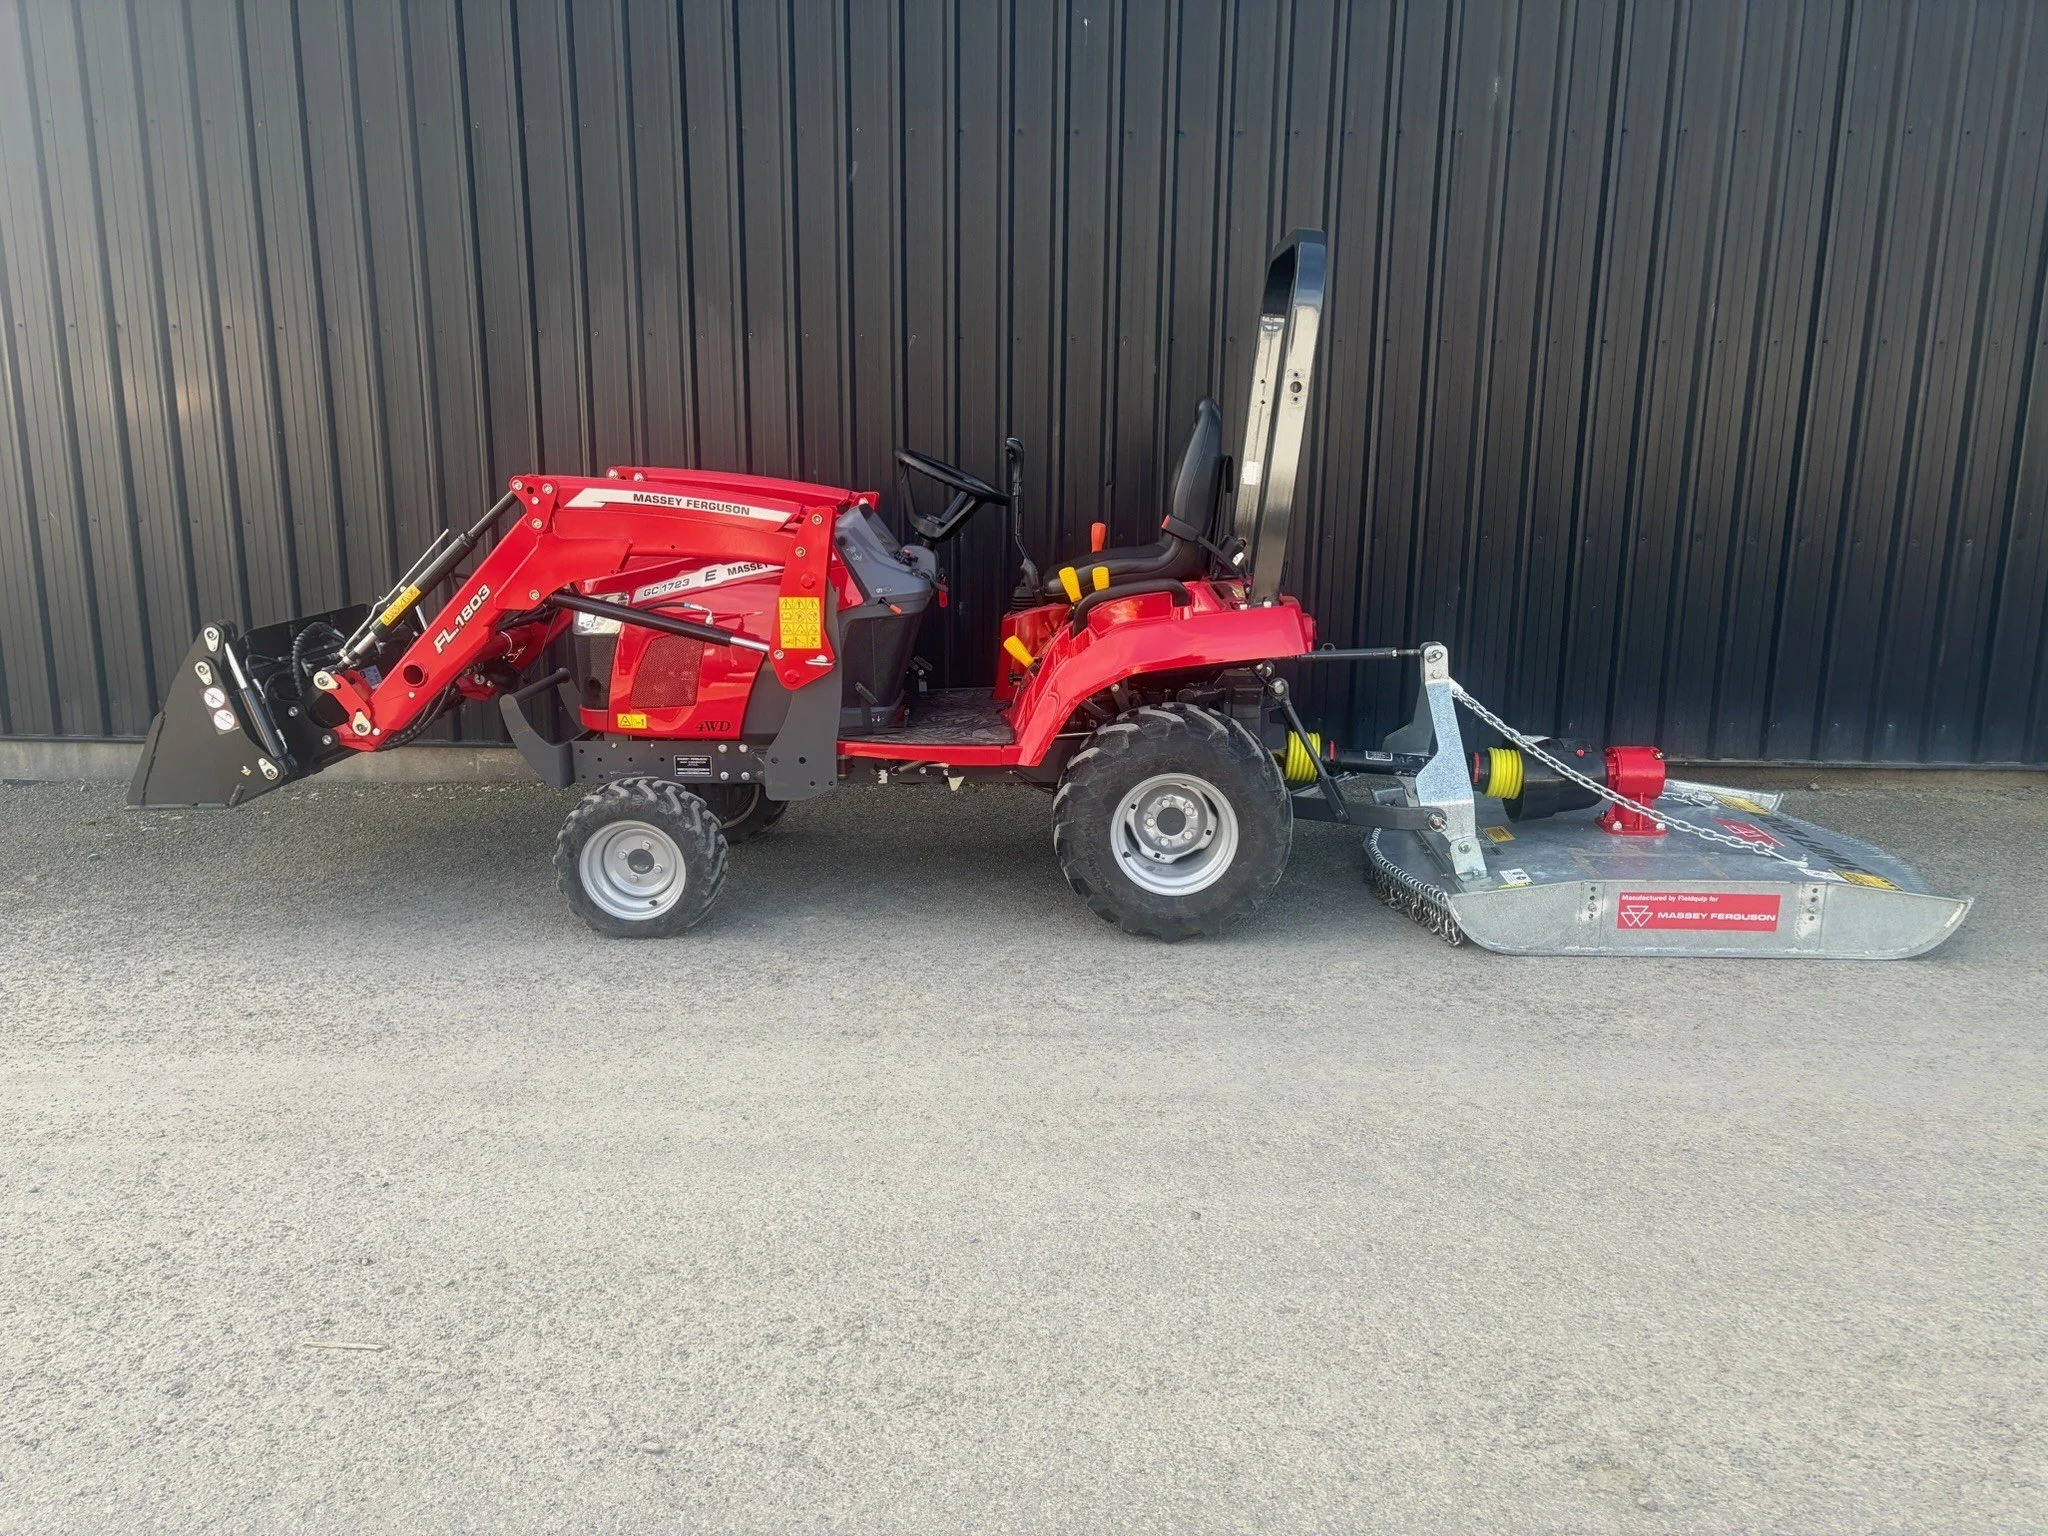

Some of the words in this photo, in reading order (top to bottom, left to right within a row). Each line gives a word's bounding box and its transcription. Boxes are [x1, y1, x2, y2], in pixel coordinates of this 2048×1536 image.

[632, 493, 683, 507] MASSEY
[686, 499, 750, 516] FERGUSON
[643, 586, 660, 597] GC
[661, 578, 690, 591] 1723
[704, 569, 717, 582] E
[696, 720, 732, 732] 4WD
[1677, 895, 1708, 903] Fieldquip
[1657, 912, 1708, 920] MASSEY
[1710, 913, 1776, 921] FERGUSON
